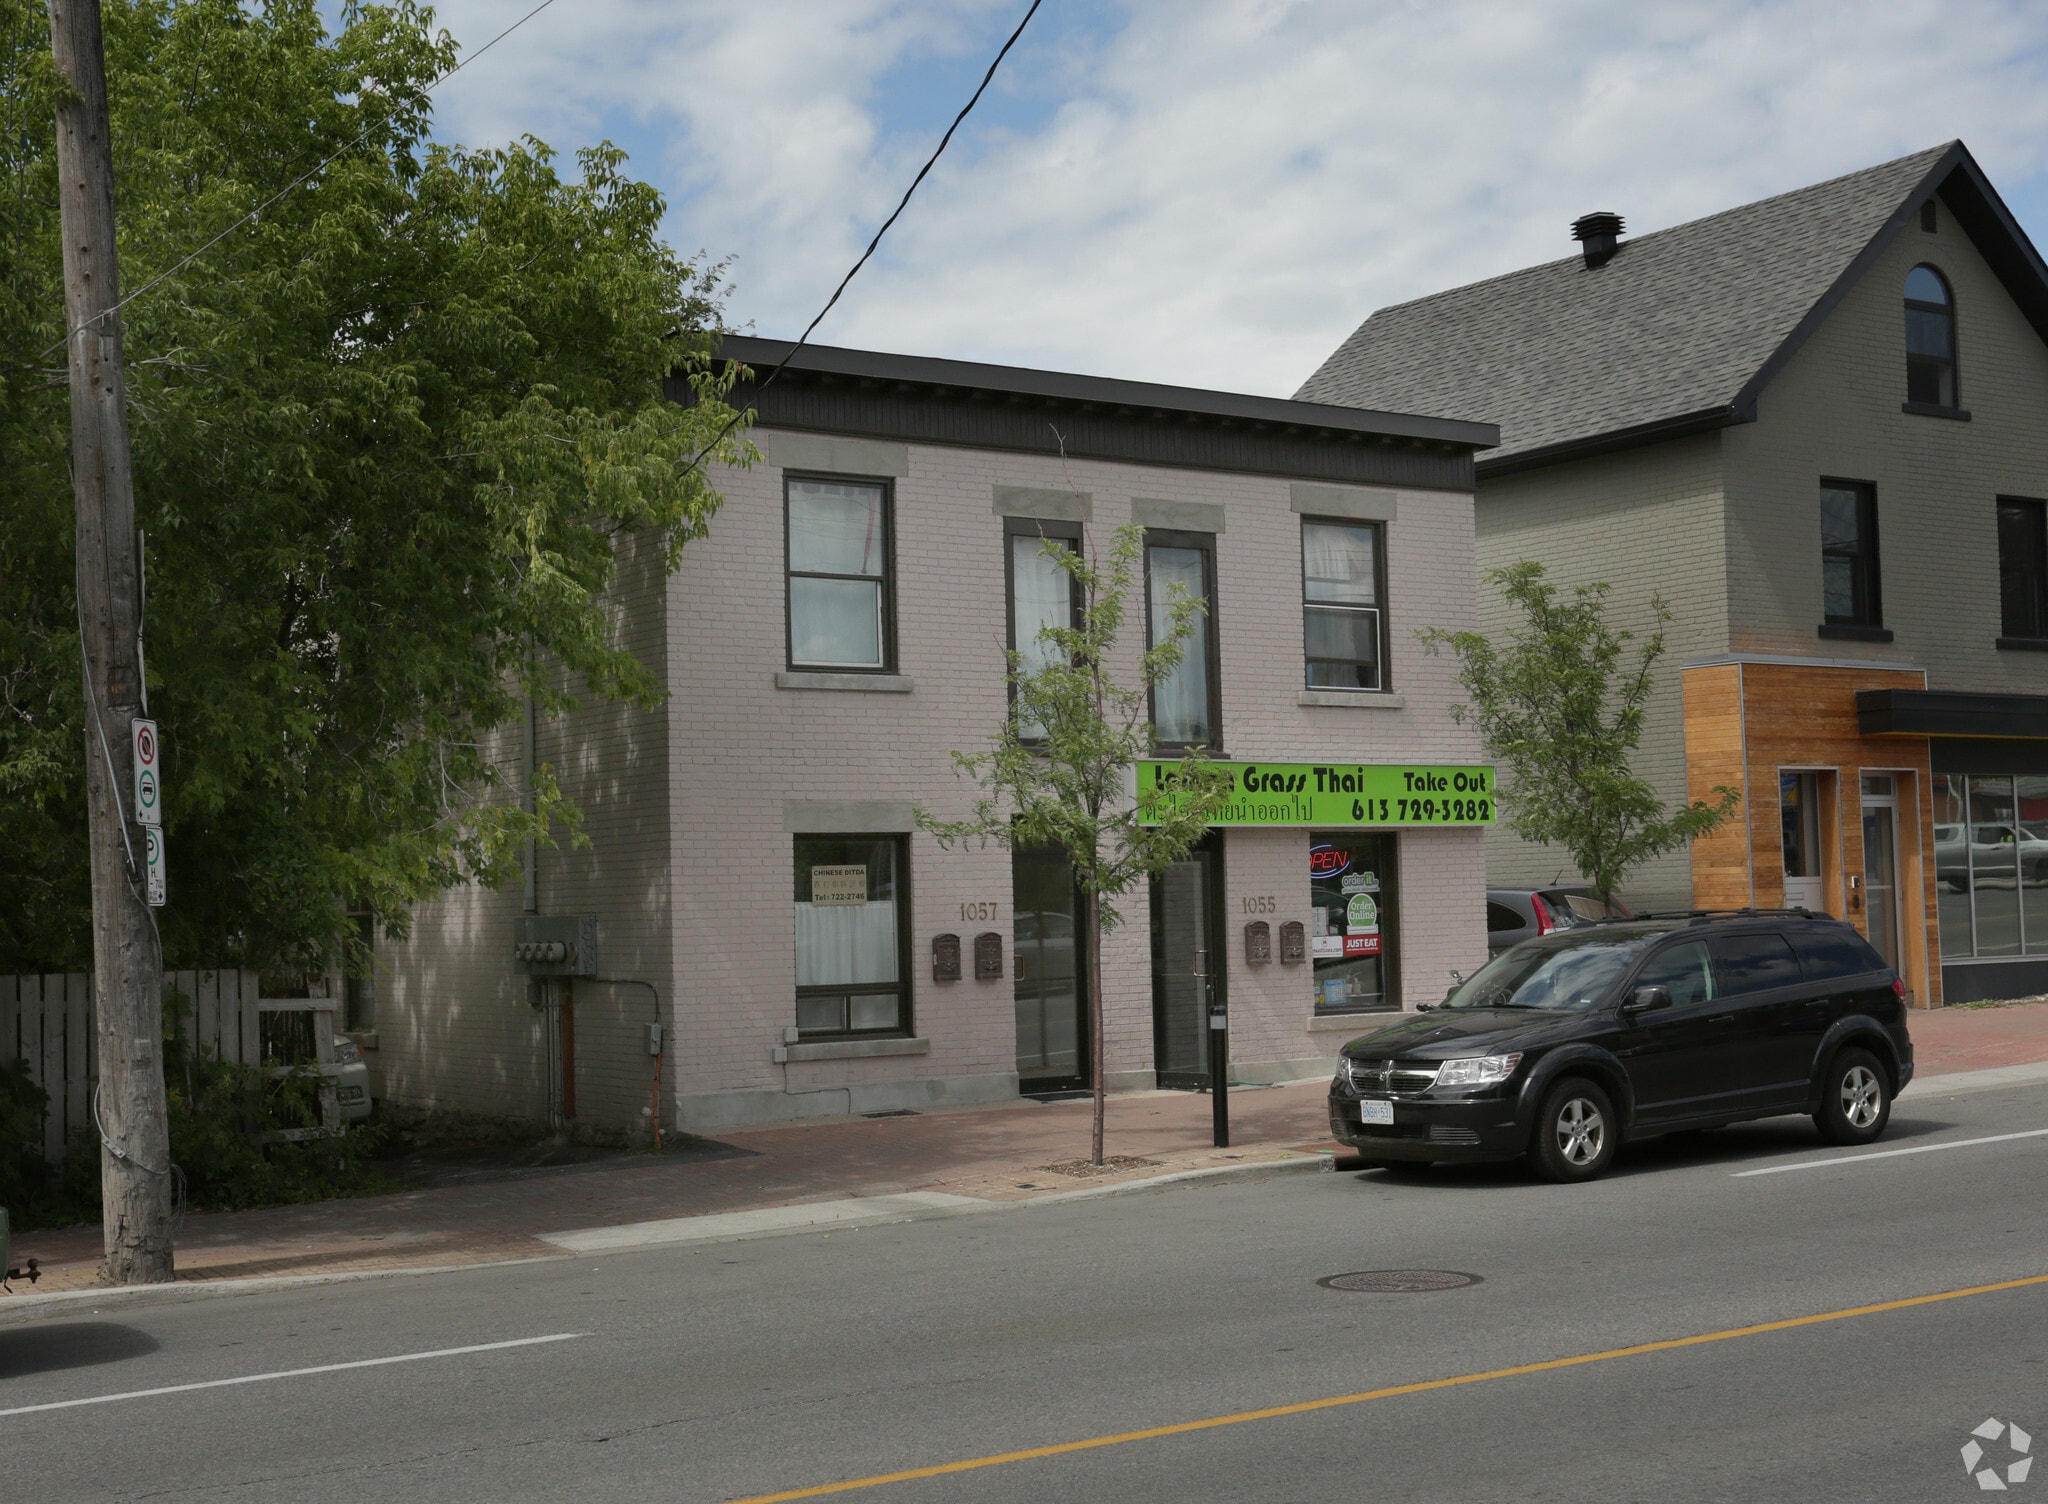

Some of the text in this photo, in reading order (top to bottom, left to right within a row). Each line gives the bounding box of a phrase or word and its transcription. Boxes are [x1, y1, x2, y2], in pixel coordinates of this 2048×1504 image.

[1243, 766, 1306, 792] Grass
[1313, 767, 1364, 793] Thai
[1404, 772, 1486, 792] Take Out
[1352, 798, 1490, 821] 613 729-3282
[1343, 874, 1364, 886] order
[831, 893, 865, 901] 722-2746
[960, 902, 998, 921] 1057
[1242, 896, 1276, 914] 1055
[1351, 901, 1372, 911] Order
[1349, 909, 1375, 920] Online
[1346, 938, 1378, 948] JUST EAT
